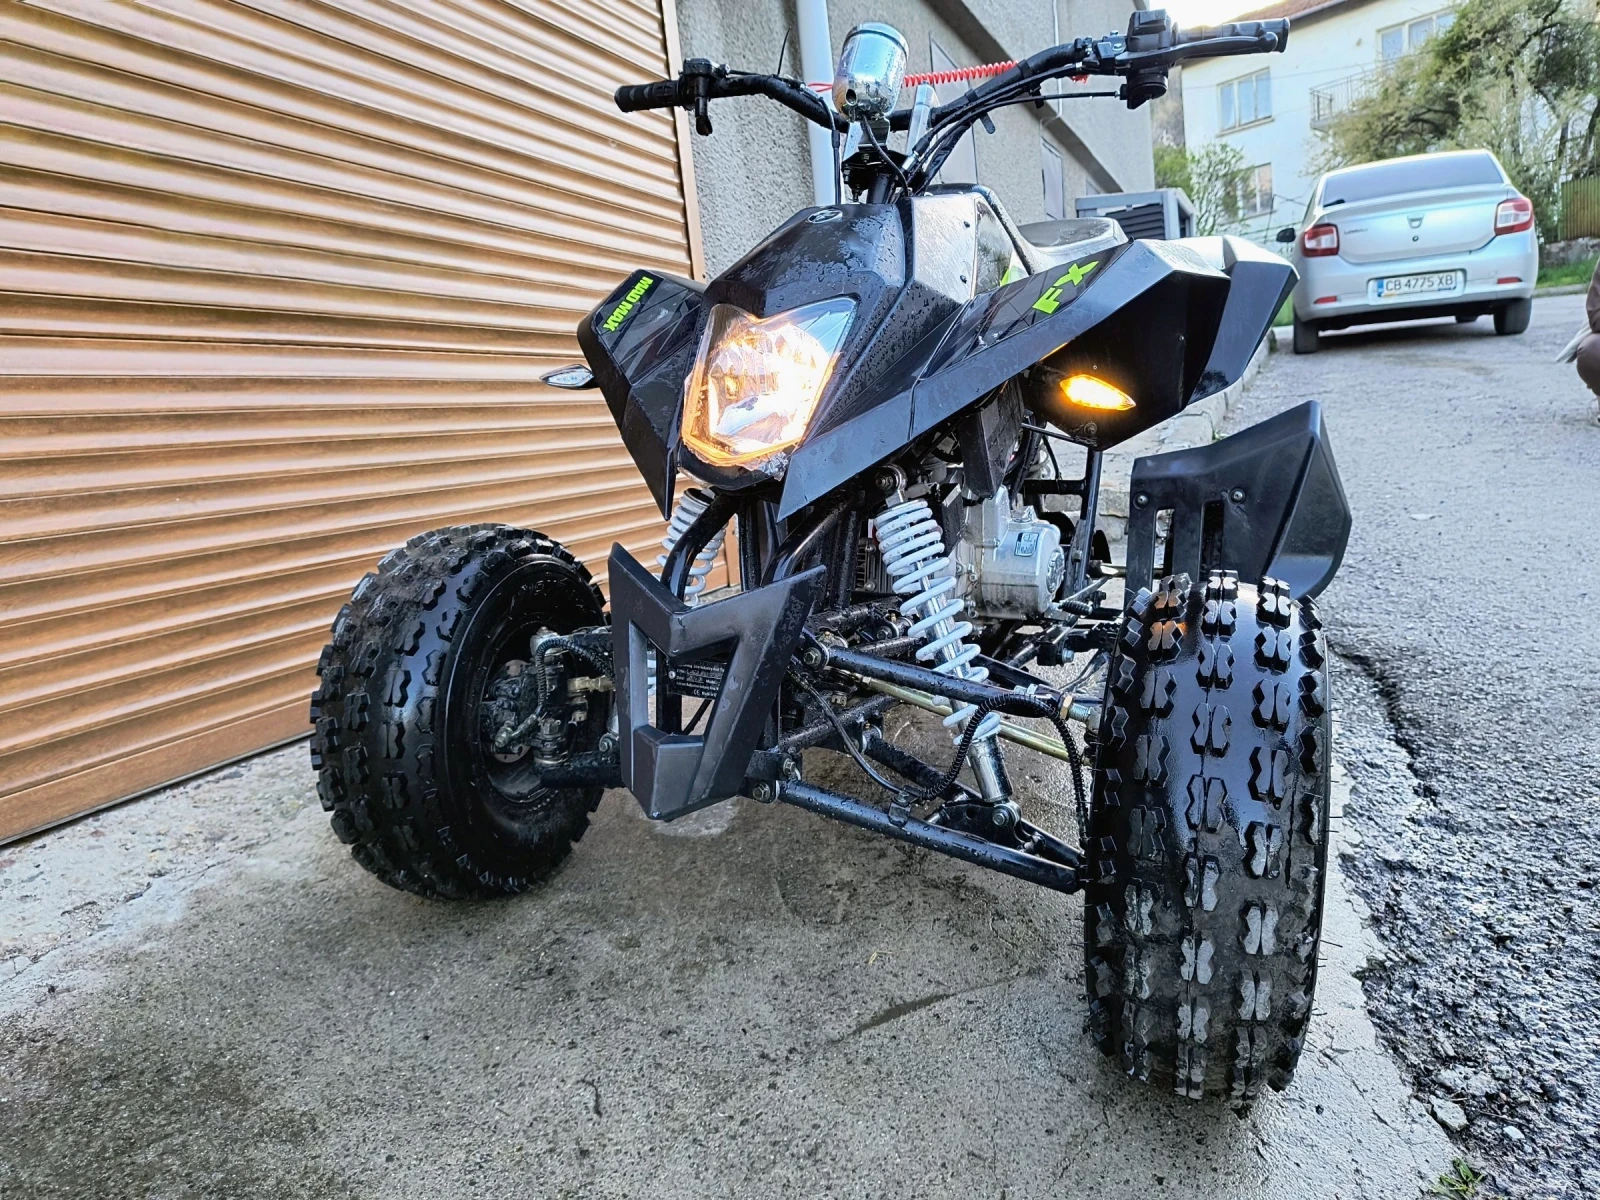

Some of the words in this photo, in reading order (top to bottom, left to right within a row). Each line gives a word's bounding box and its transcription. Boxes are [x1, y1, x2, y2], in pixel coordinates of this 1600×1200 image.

[625, 276, 654, 303] MAD
[1032, 260, 1100, 314] FX
[1386, 280, 1401, 292] CB
[1404, 276, 1434, 289] 4775
[1437, 274, 1454, 287] XB
[602, 301, 633, 332] MAX
